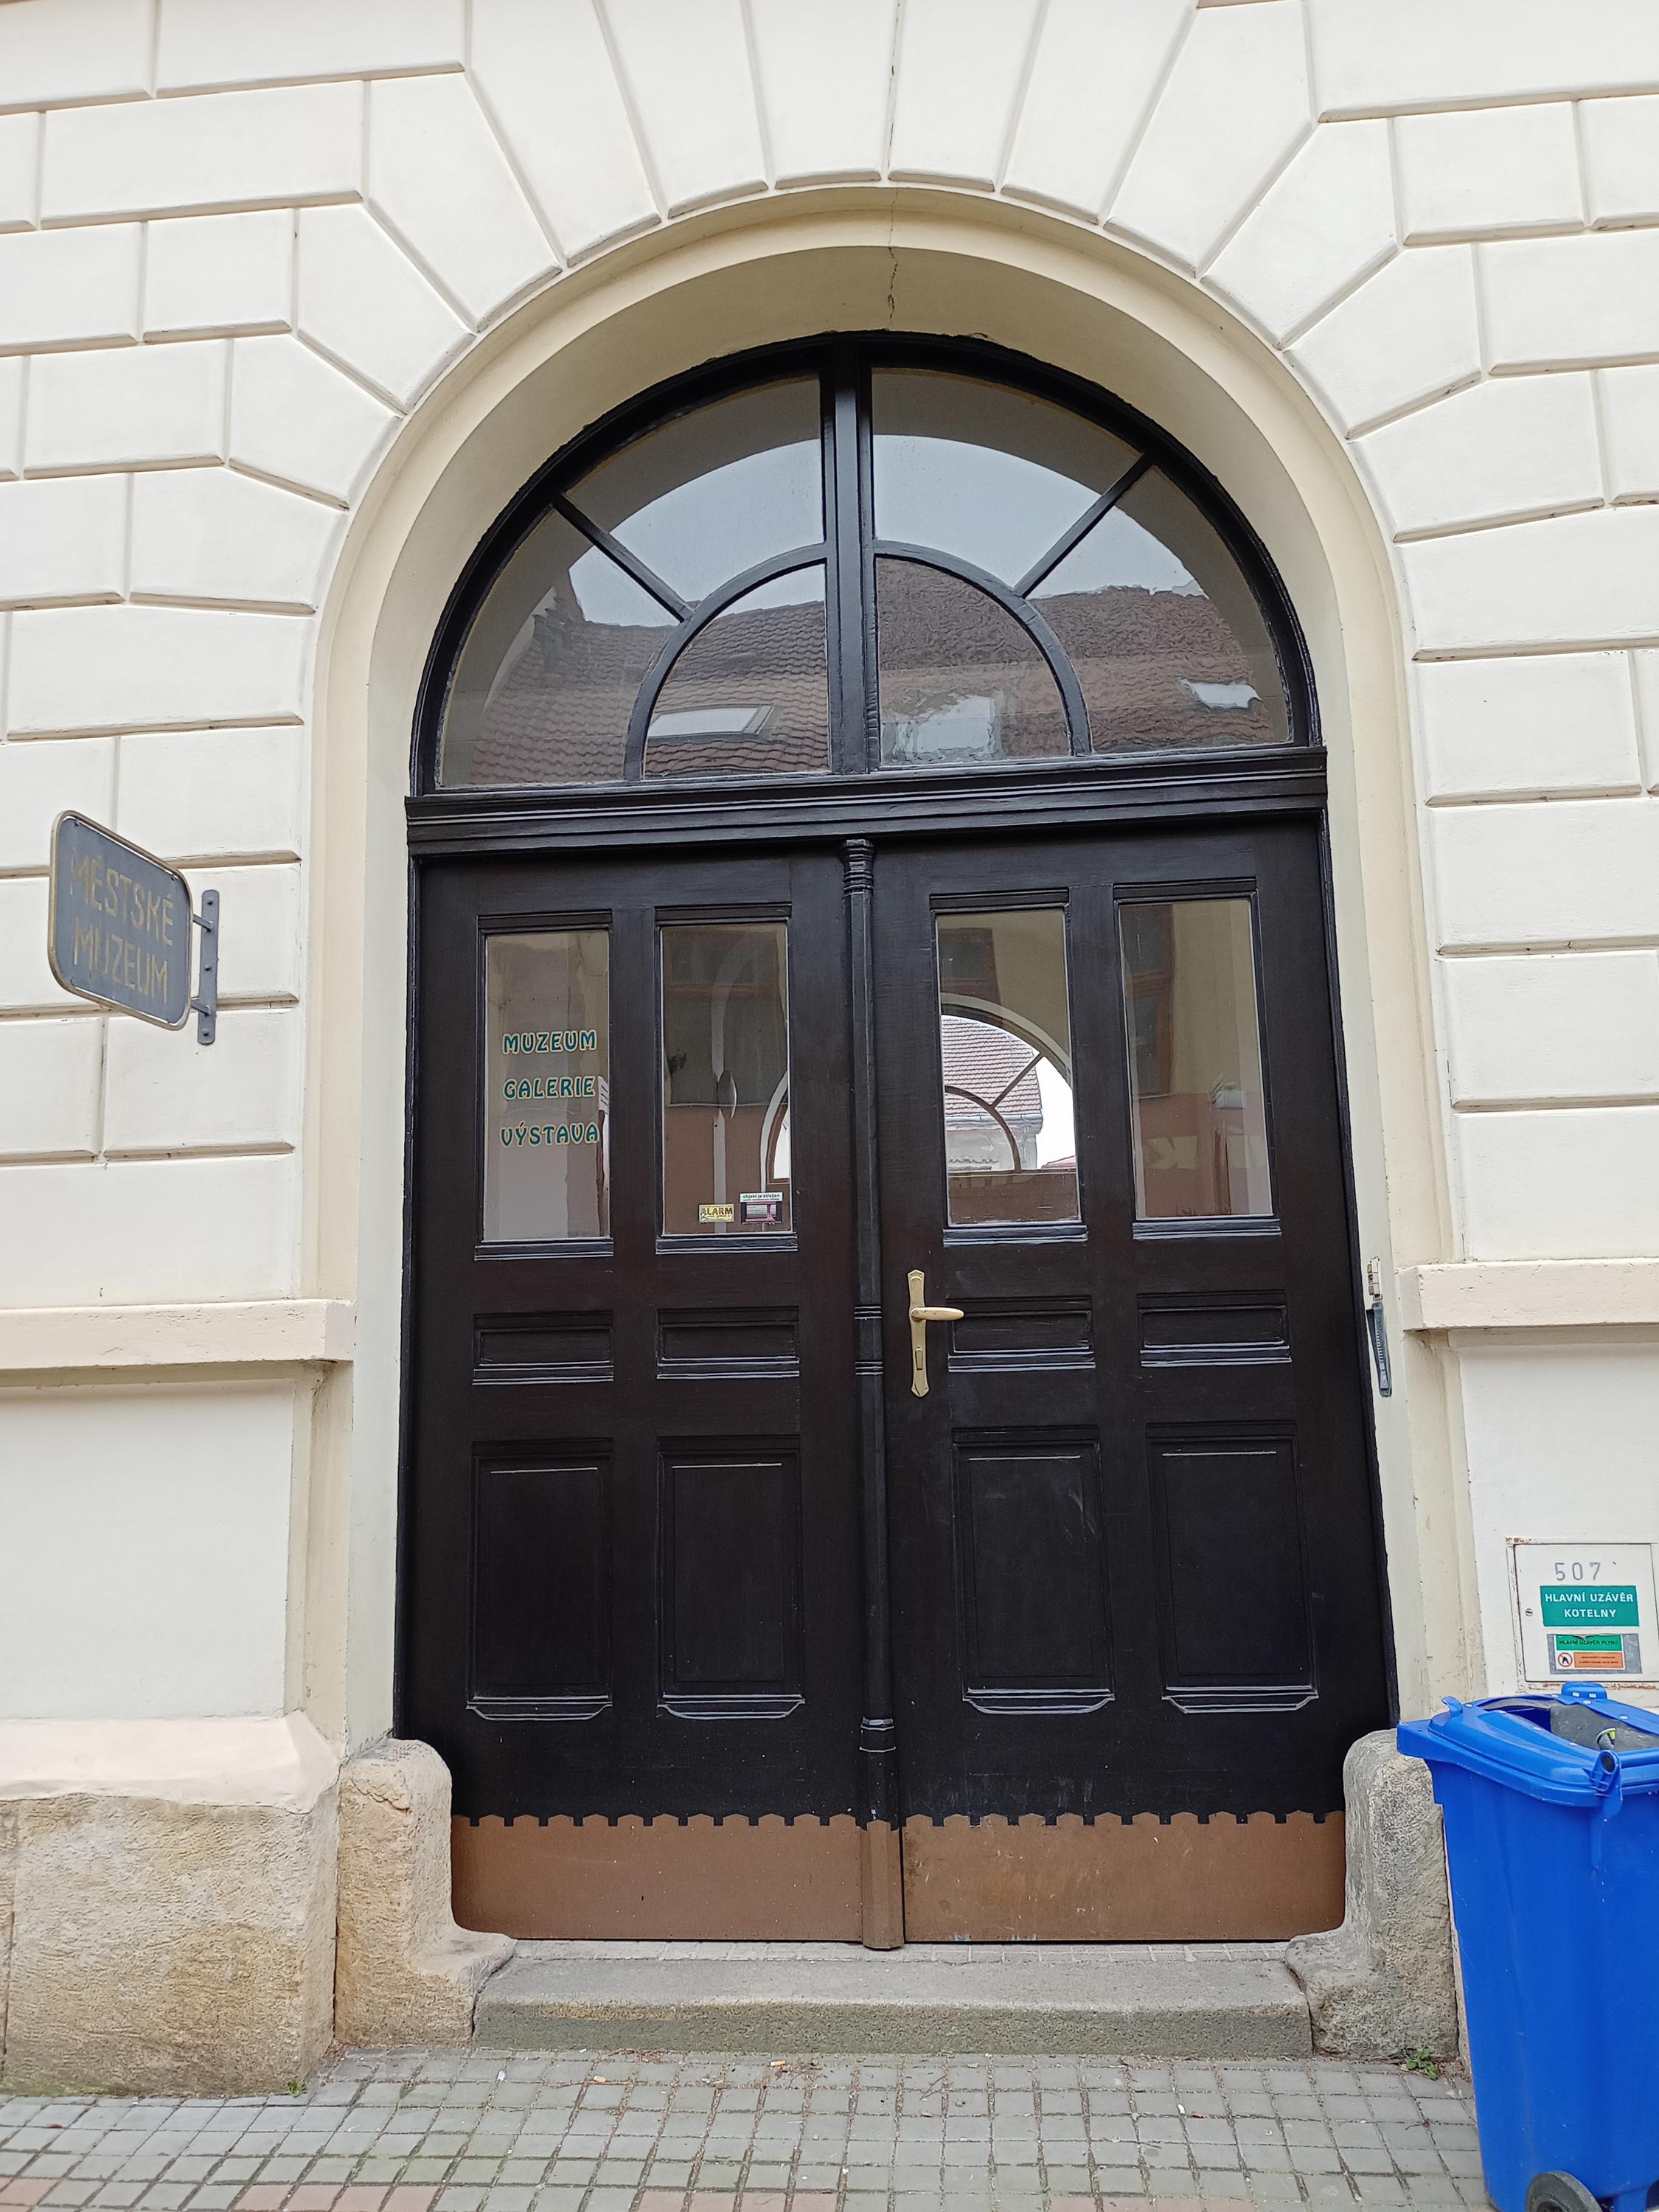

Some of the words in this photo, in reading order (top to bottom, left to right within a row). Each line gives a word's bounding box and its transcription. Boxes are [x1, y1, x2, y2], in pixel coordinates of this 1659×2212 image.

[74, 917, 168, 1004] MUZEUM
[503, 1029, 597, 1054] MUZEUM
[503, 1076, 596, 1100] GALERIE
[501, 1120, 600, 1147] VÝSTAVA
[700, 1207, 733, 1216] ALARM
[1554, 1562, 1601, 1582] 507
[1545, 1592, 1586, 1602] HLAVNÍ
[1590, 1592, 1634, 1602] UZÁVĚR
[1564, 1609, 1617, 1618] KOTELNY
